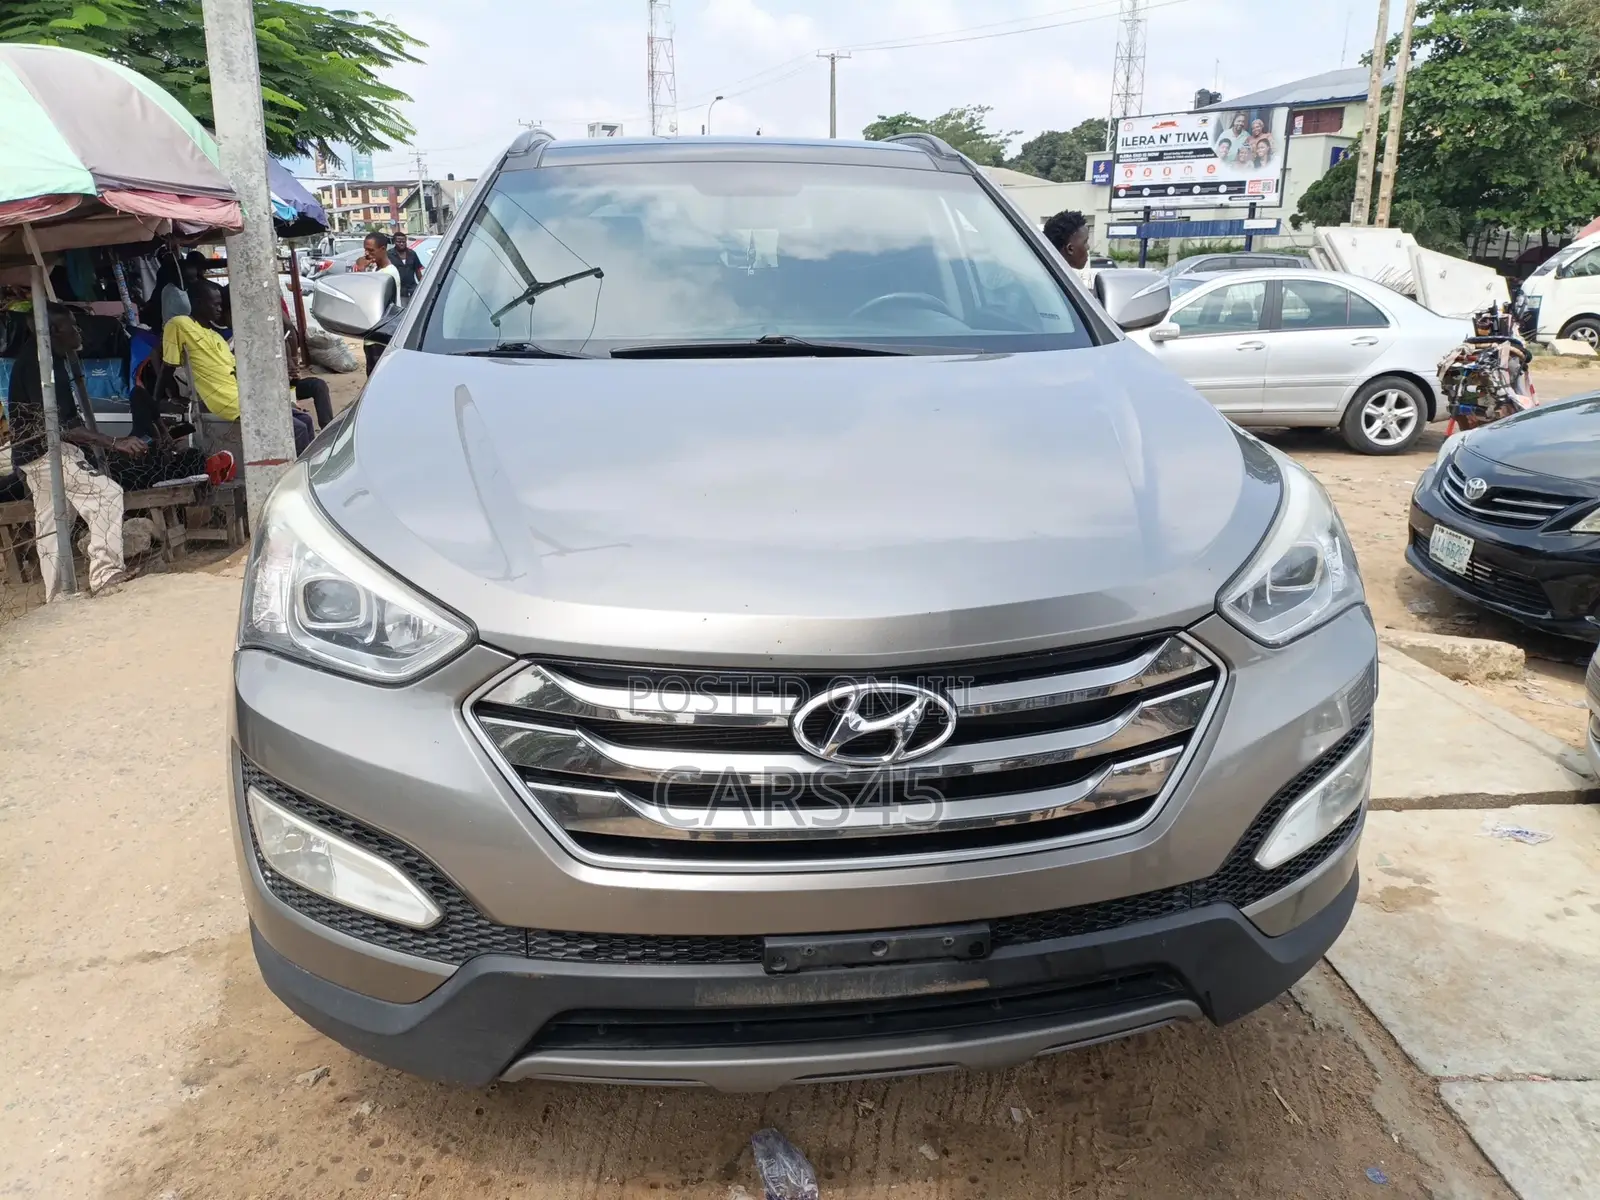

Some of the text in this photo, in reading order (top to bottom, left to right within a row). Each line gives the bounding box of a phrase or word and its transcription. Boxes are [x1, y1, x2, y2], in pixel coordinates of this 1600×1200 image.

[1121, 135, 1156, 147] ILERA
[1159, 133, 1172, 144] N'
[1175, 131, 1209, 143] TIWA
